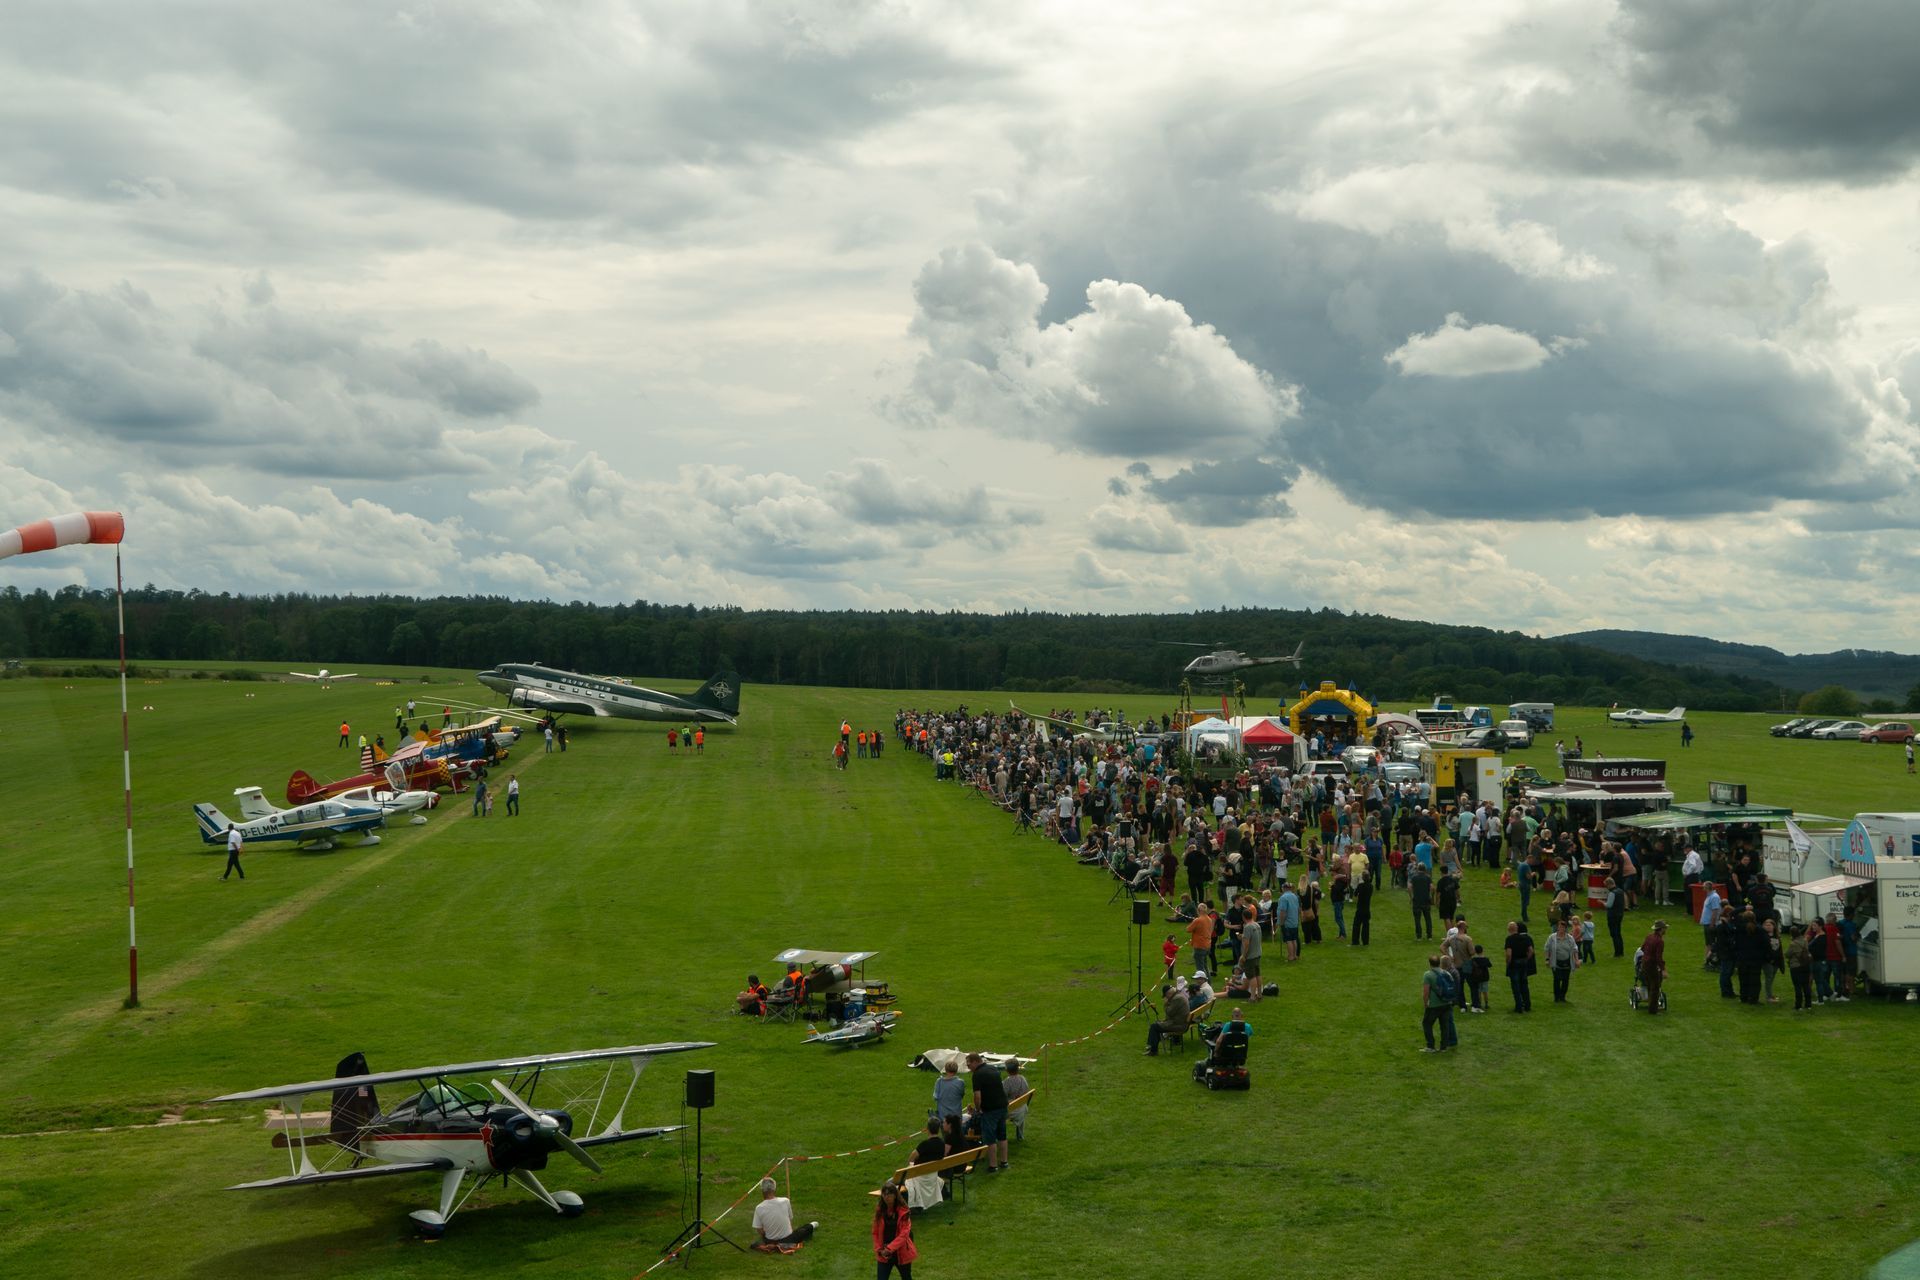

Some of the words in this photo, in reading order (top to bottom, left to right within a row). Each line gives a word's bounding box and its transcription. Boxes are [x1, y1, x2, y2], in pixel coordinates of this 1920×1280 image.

[1602, 768, 1619, 777] Grill
[1620, 768, 1629, 777] &
[1630, 767, 1658, 777] Pfanne
[240, 824, 279, 838] D-ELMM
